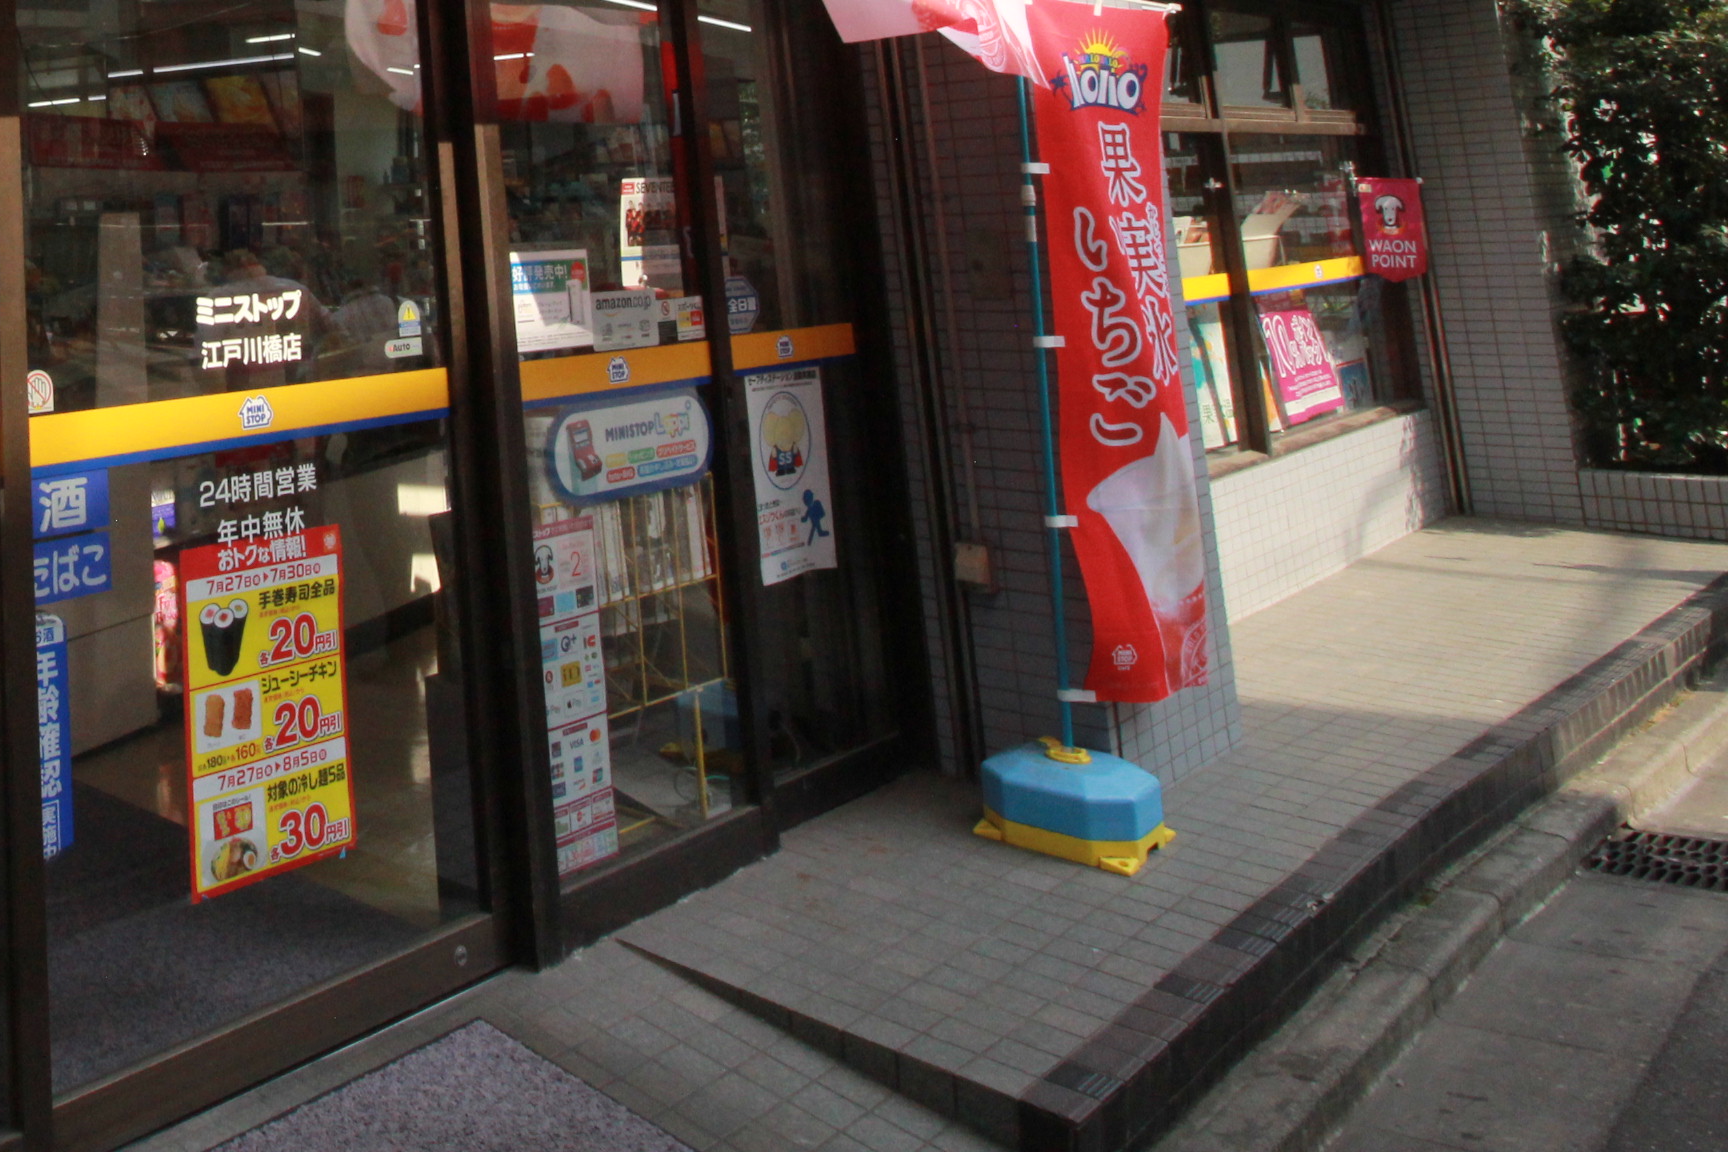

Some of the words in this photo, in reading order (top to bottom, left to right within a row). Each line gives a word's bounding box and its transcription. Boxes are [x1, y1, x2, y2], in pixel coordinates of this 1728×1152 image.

[1099, 121, 1179, 387] 果実氷
[1368, 239, 1417, 253] WAON
[1371, 254, 1417, 268] POINT
[196, 289, 302, 326] ミニストップ
[1073, 206, 1156, 446] いちご
[201, 333, 302, 370] 江戸川橋店
[393, 343, 411, 352] Auto
[246, 403, 265, 415] MINI
[246, 414, 266, 425] STOP
[199, 462, 317, 508] 24時間営業
[39, 477, 88, 532] 酒
[217, 506, 305, 547] 年中無休
[217, 535, 307, 572] おトクな情報!
[258, 579, 335, 610] 手巻寿司全品
[261, 661, 337, 695] ジューシーチキン
